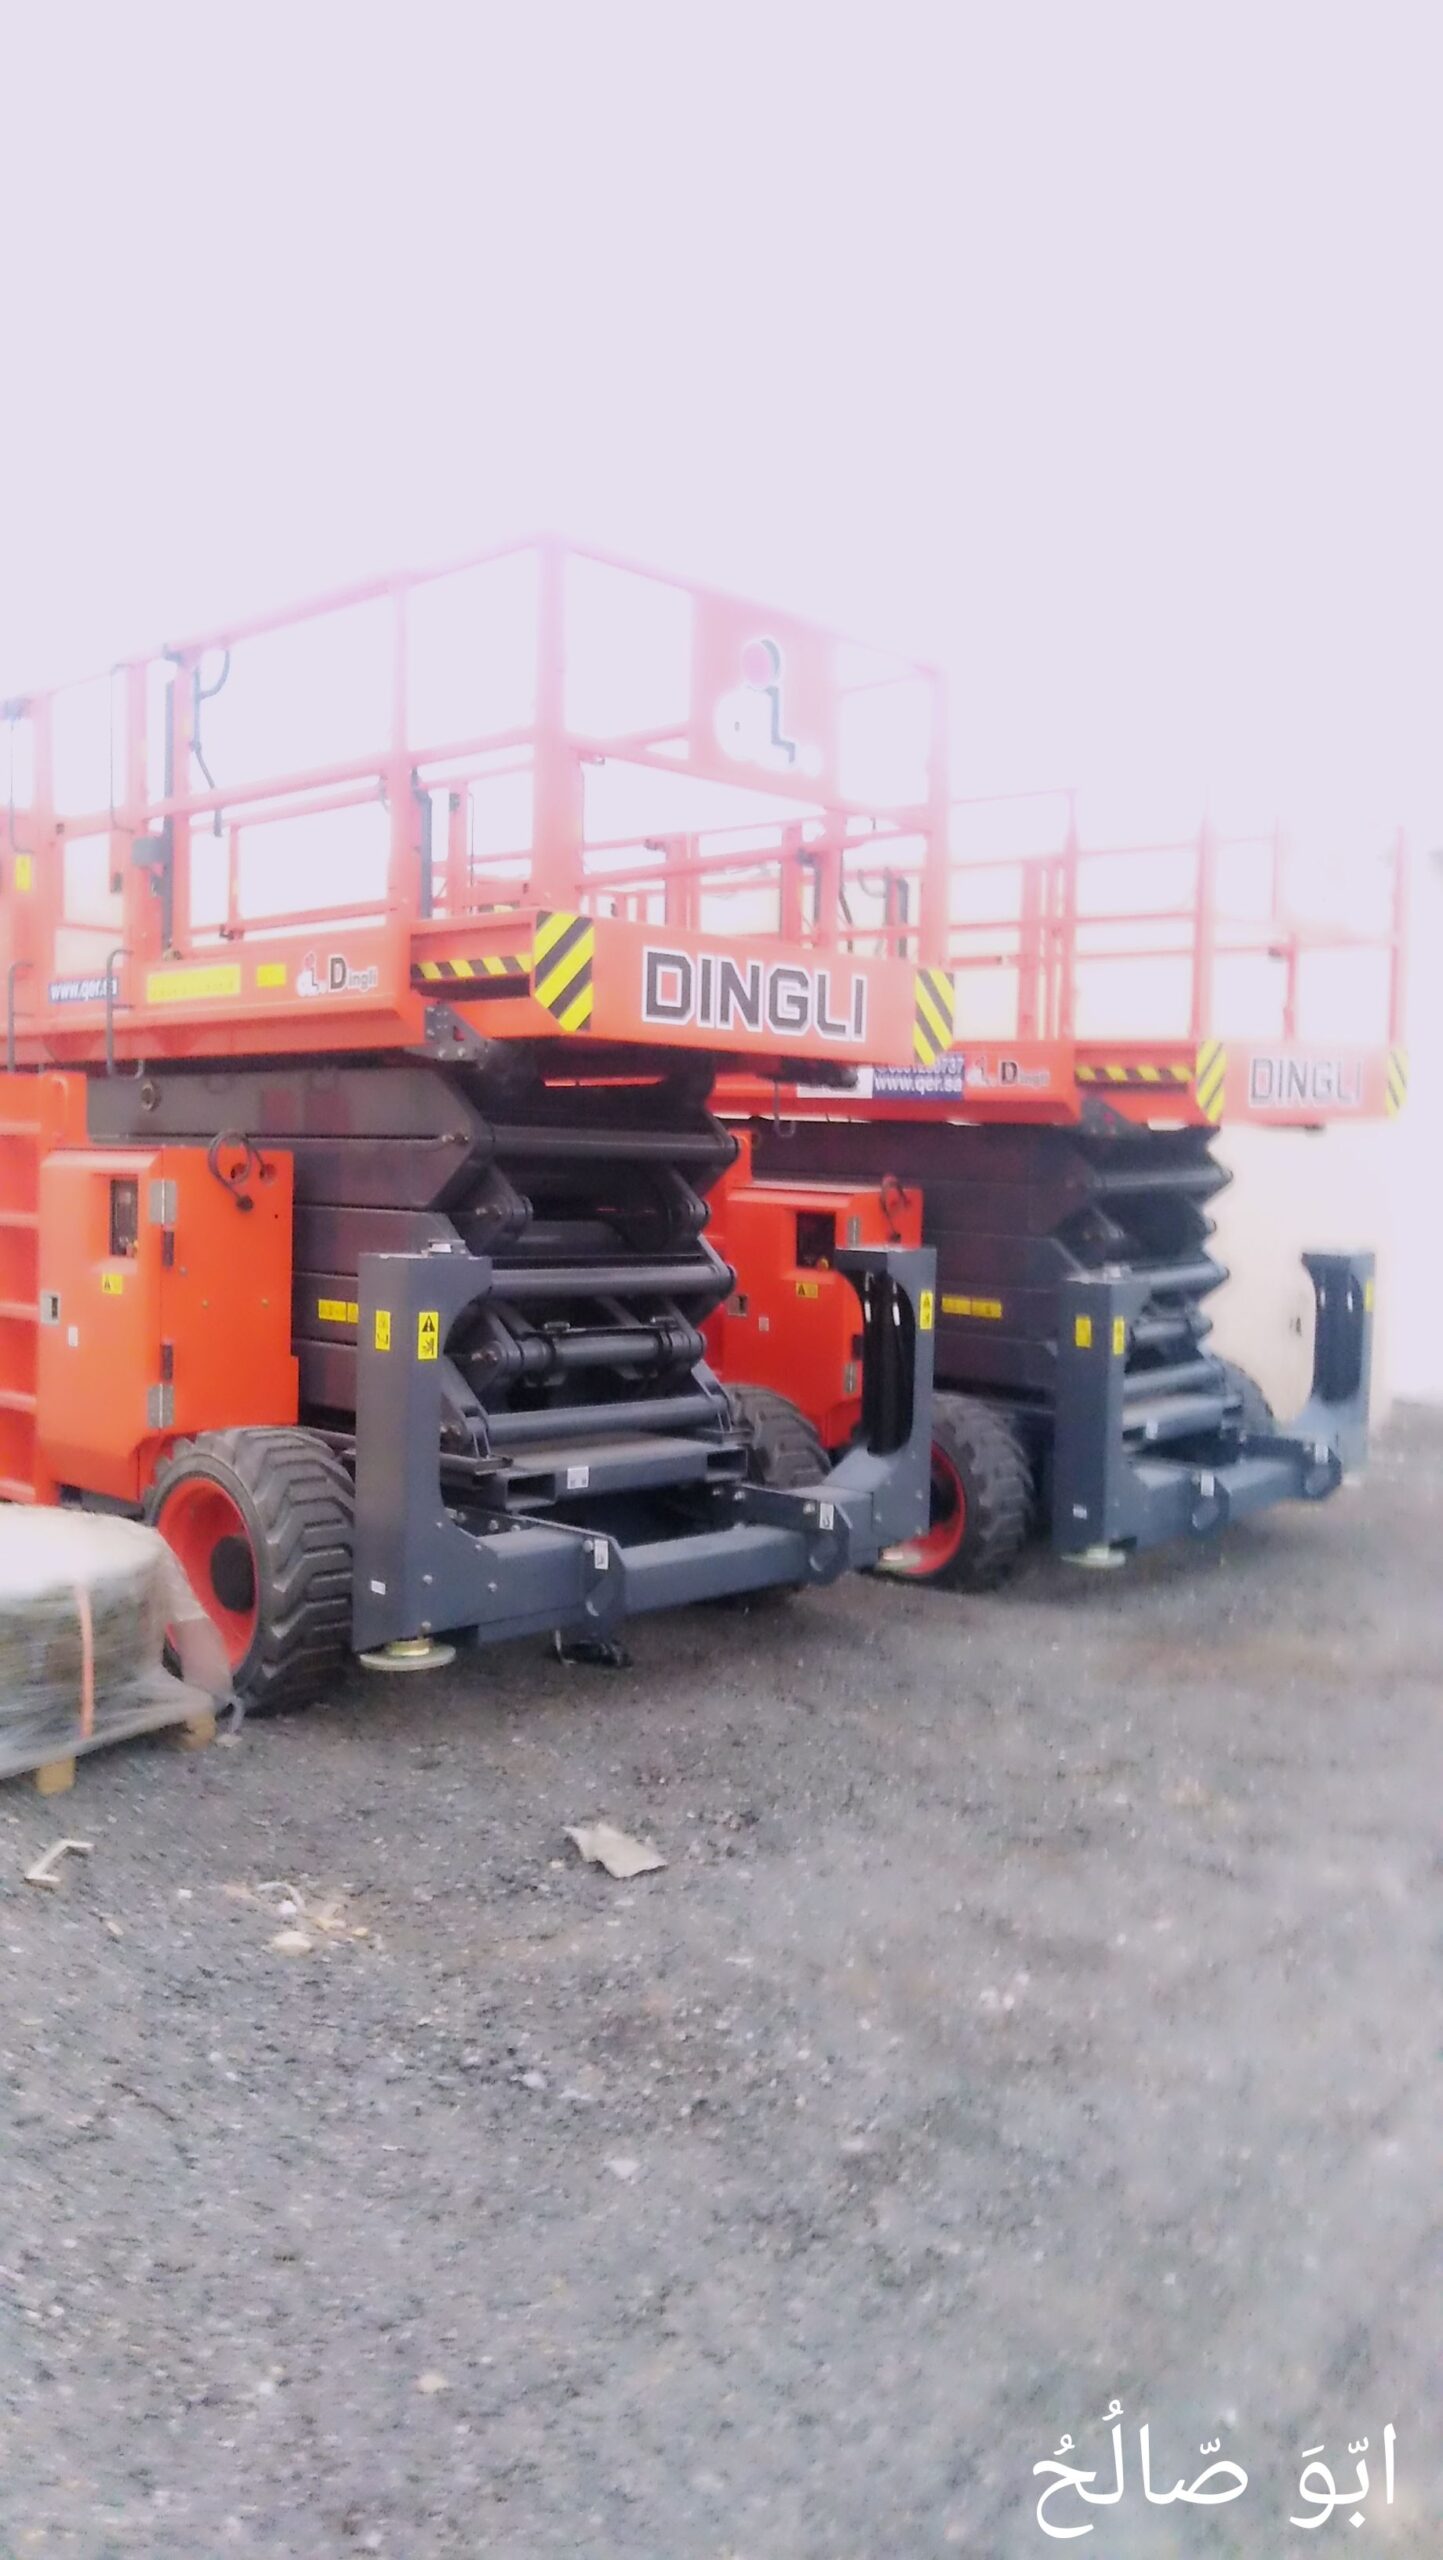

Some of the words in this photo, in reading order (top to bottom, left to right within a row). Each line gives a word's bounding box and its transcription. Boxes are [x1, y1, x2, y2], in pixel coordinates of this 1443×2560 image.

[329, 955, 378, 991] Dingli
[643, 947, 866, 1041] DINGLI
[1250, 1057, 1363, 1106] DINGLI
